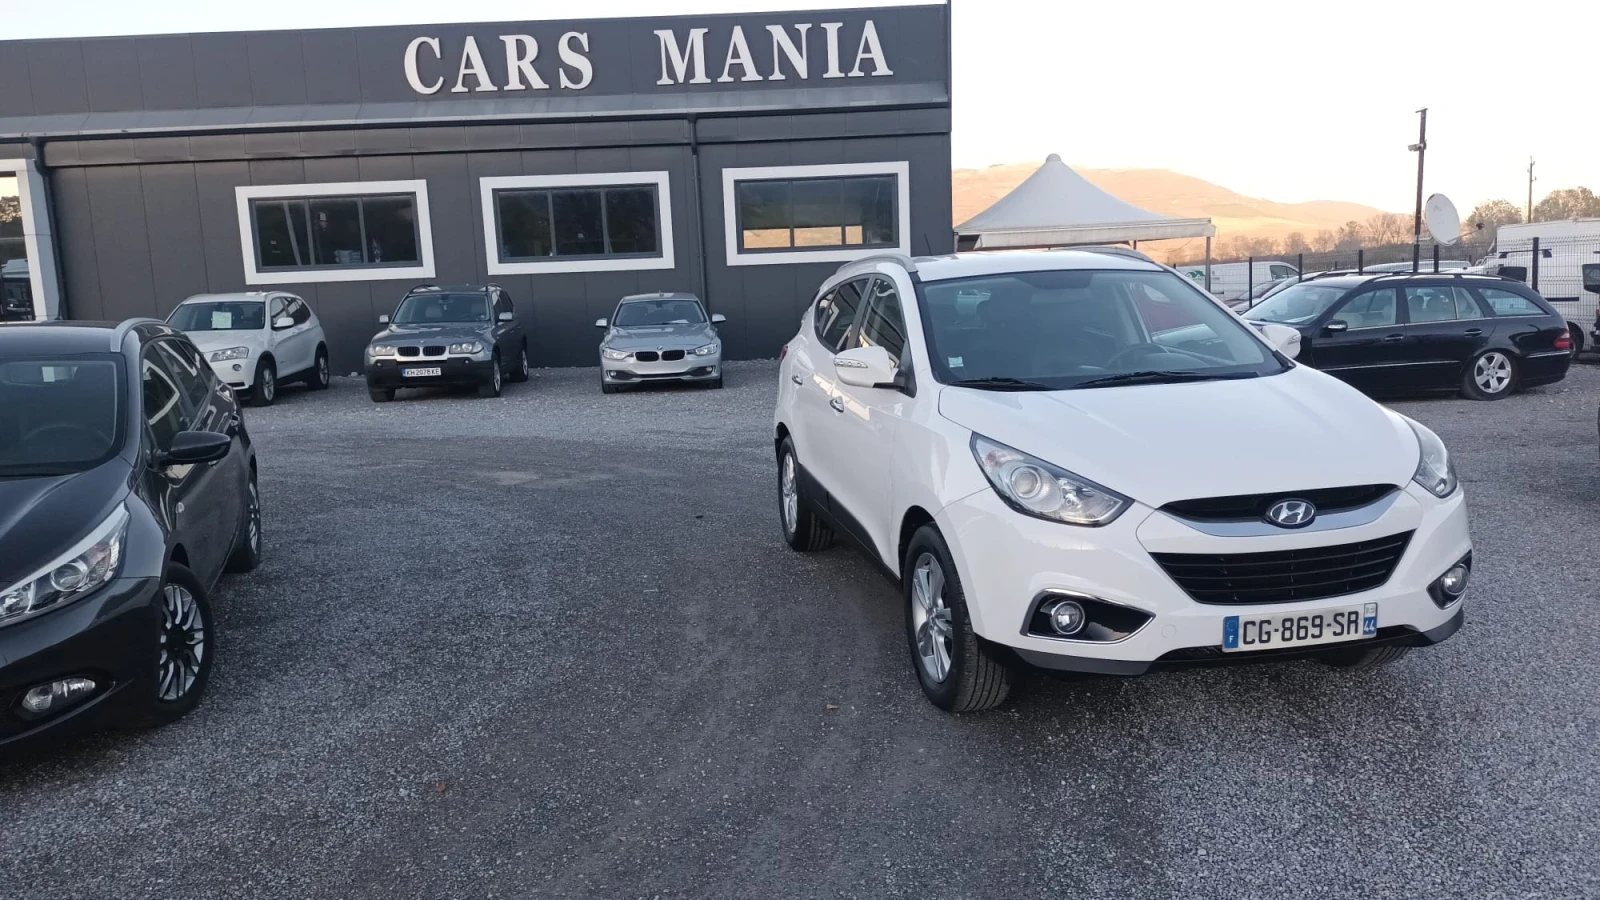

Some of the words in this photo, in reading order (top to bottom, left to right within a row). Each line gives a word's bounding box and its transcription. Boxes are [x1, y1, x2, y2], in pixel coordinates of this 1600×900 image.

[403, 31, 594, 95] CARS
[653, 19, 894, 86] MANIA
[1229, 635, 1234, 643] F
[1243, 611, 1359, 645] CG-869-SR
[1363, 619, 1375, 632] 44
